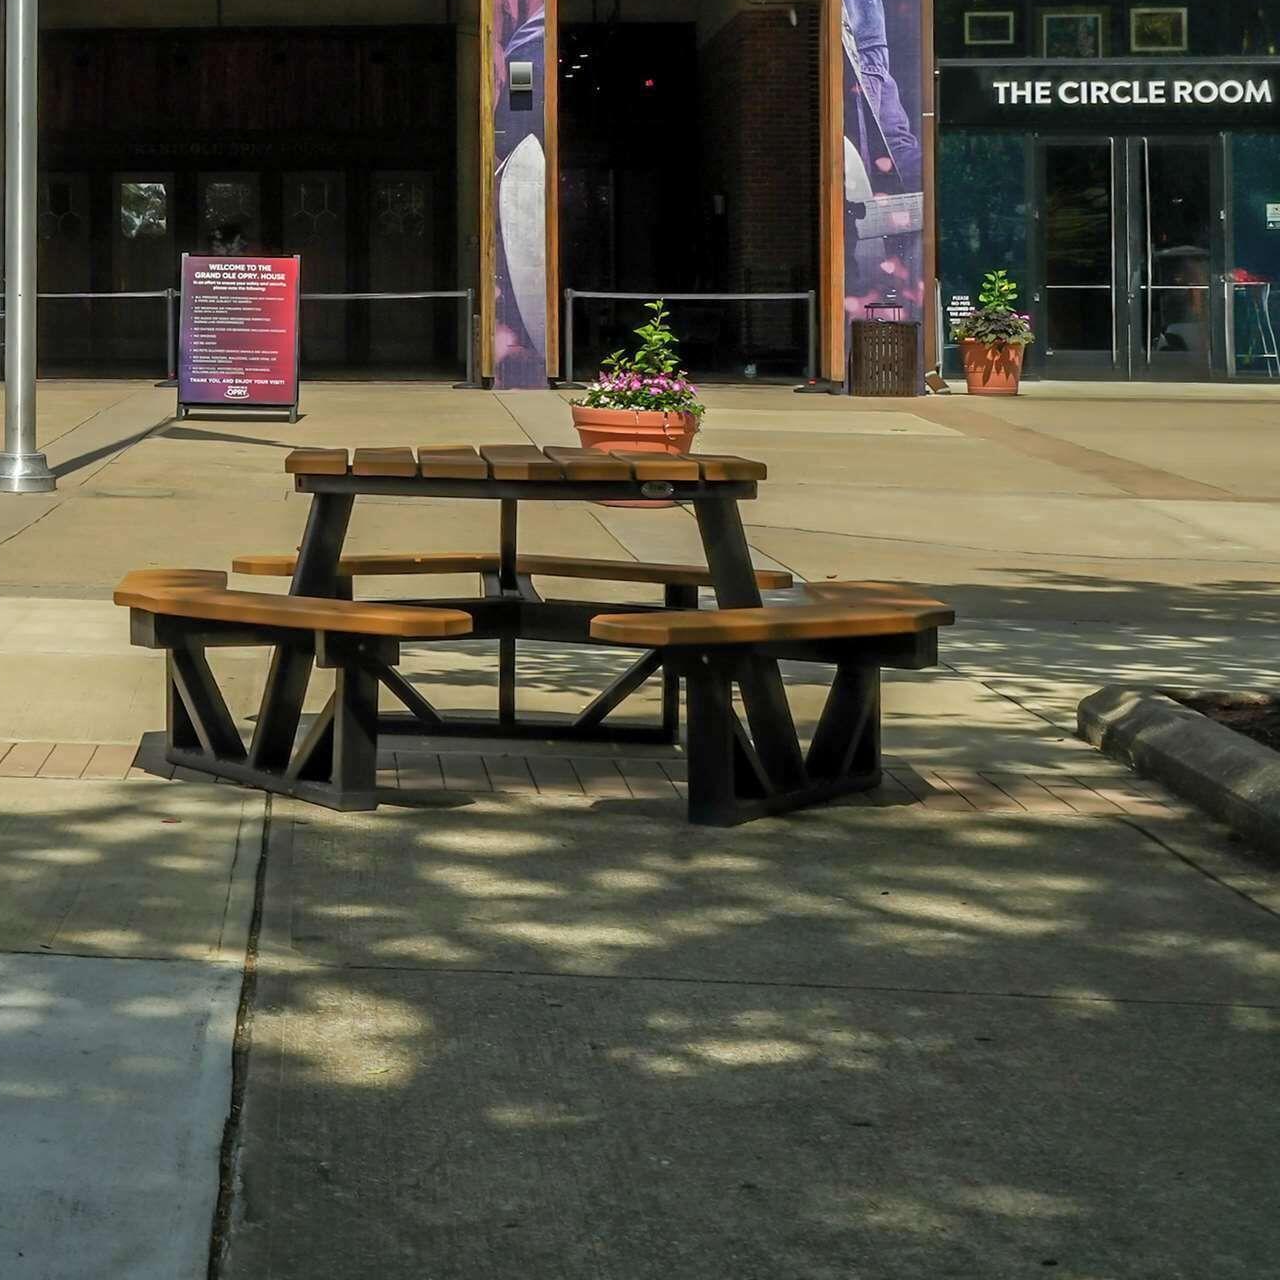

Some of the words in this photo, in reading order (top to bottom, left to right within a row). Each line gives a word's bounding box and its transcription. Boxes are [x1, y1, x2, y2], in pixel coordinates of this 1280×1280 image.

[993, 81, 1052, 104] THE
[1058, 80, 1166, 104] CIRCLE
[1173, 79, 1272, 104] ROOM
